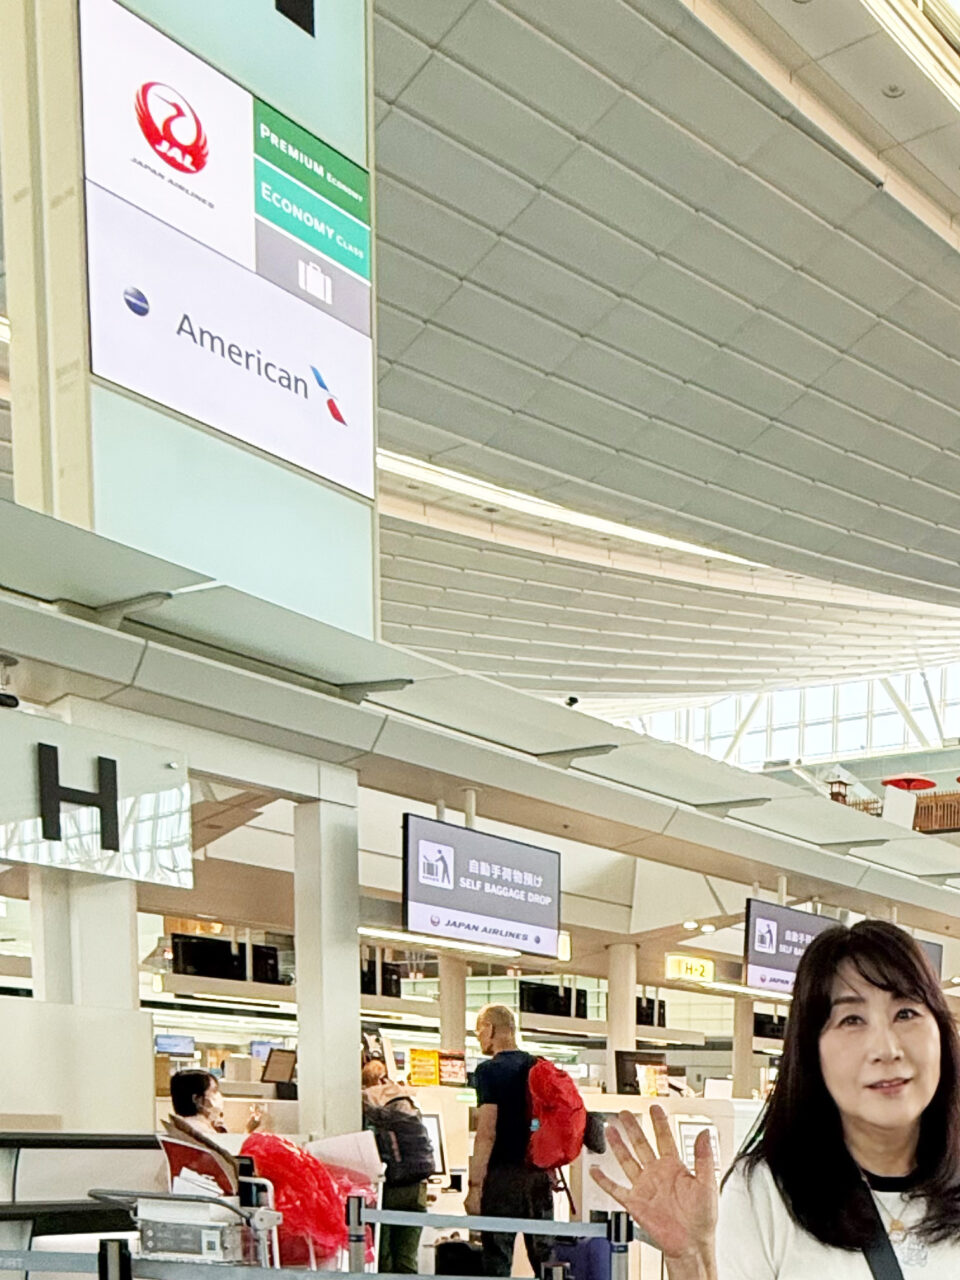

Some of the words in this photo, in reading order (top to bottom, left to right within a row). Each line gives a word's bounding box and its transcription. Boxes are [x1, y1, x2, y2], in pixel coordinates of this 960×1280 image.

[155, 140, 196, 171] JAL
[260, 123, 324, 178] PREMIUM
[131, 158, 165, 179] JAPAN
[168, 179, 214, 208] AIRLINES
[261, 182, 335, 239] ECONOMY
[176, 314, 308, 399] American
[38, 742, 119, 852] H
[459, 877, 482, 891] SELF
[484, 882, 526, 901] BAGGAGE
[527, 891, 552, 905] DROP
[468, 859, 543, 887] 自動手荷物預け
[445, 919, 479, 932] JAPAN
[481, 927, 528, 941] AIRLINES
